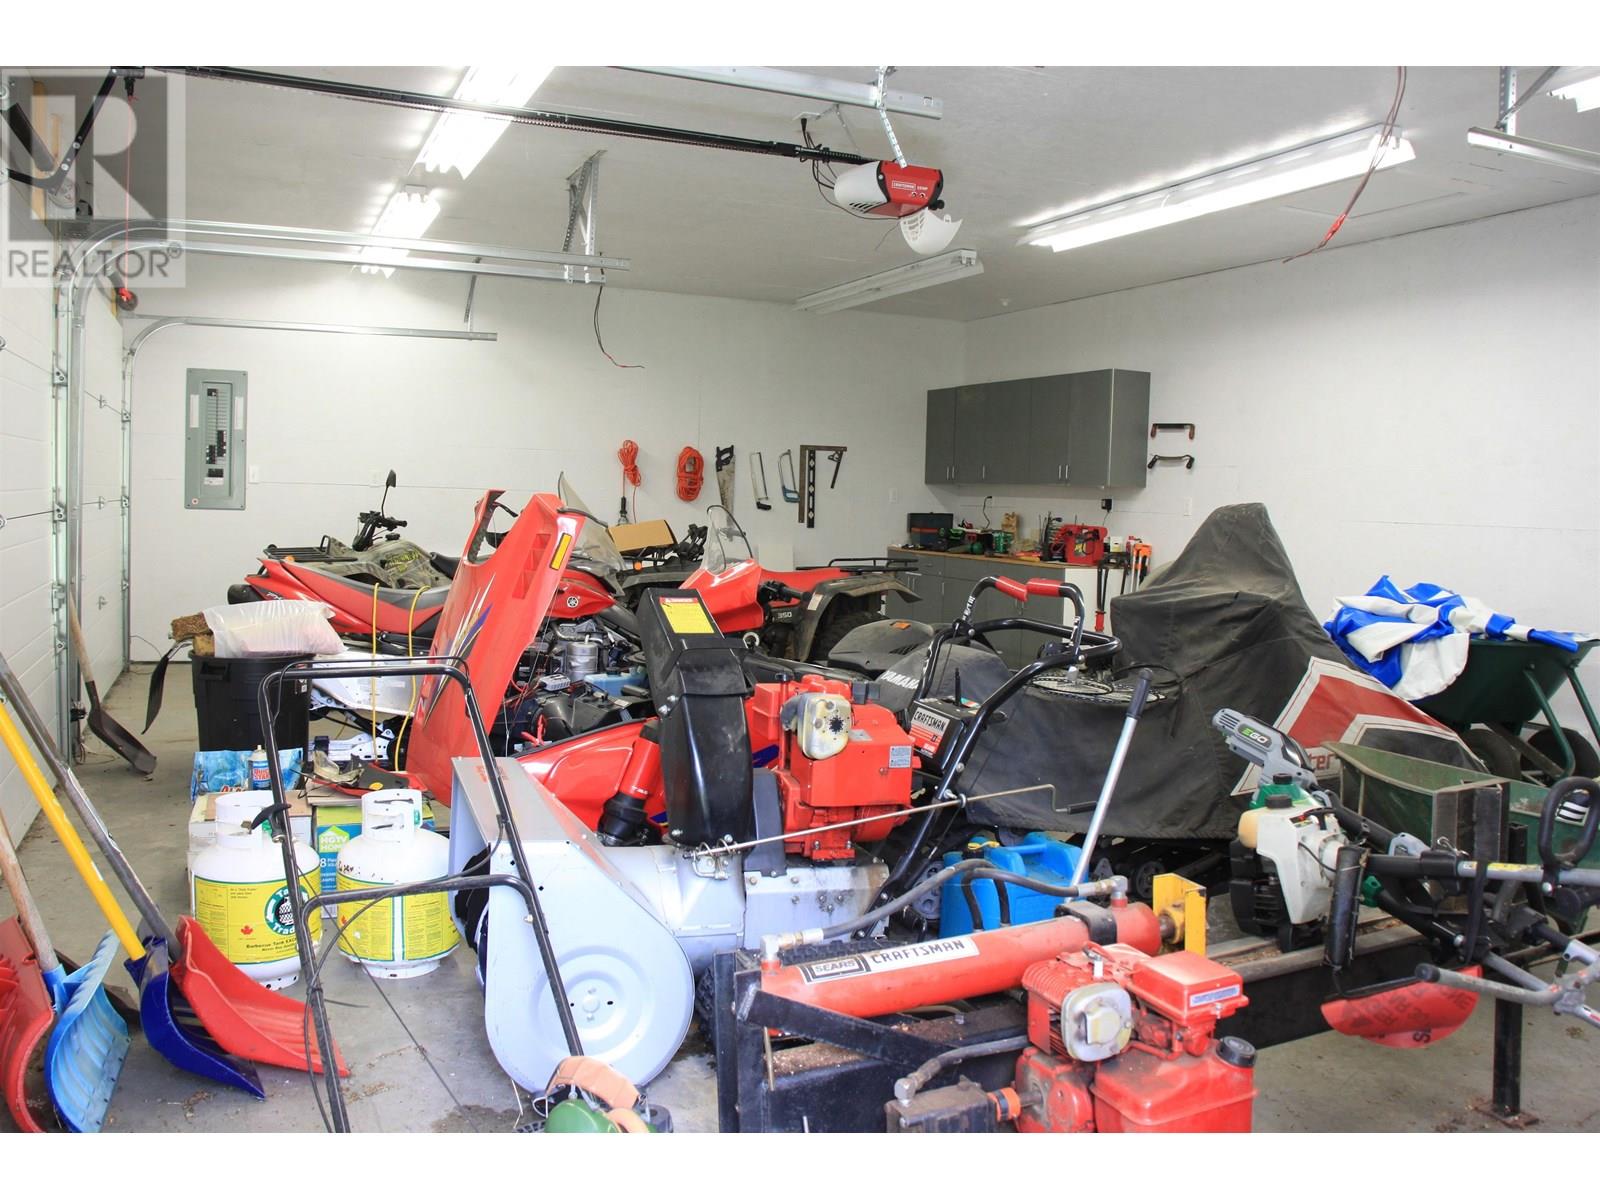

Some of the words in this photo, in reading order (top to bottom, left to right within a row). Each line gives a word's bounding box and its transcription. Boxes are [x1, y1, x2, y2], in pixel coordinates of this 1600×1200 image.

[777, 611, 793, 619] 350
[880, 670, 920, 690] YAMAH
[913, 711, 946, 732] CRAFTSMAN
[1241, 727, 1268, 744] EGO
[320, 843, 344, 851] HOM
[320, 857, 327, 867] 8
[272, 922, 296, 935] Trad
[814, 959, 856, 973] SEARS
[870, 939, 965, 964] CRAFTSMAN
